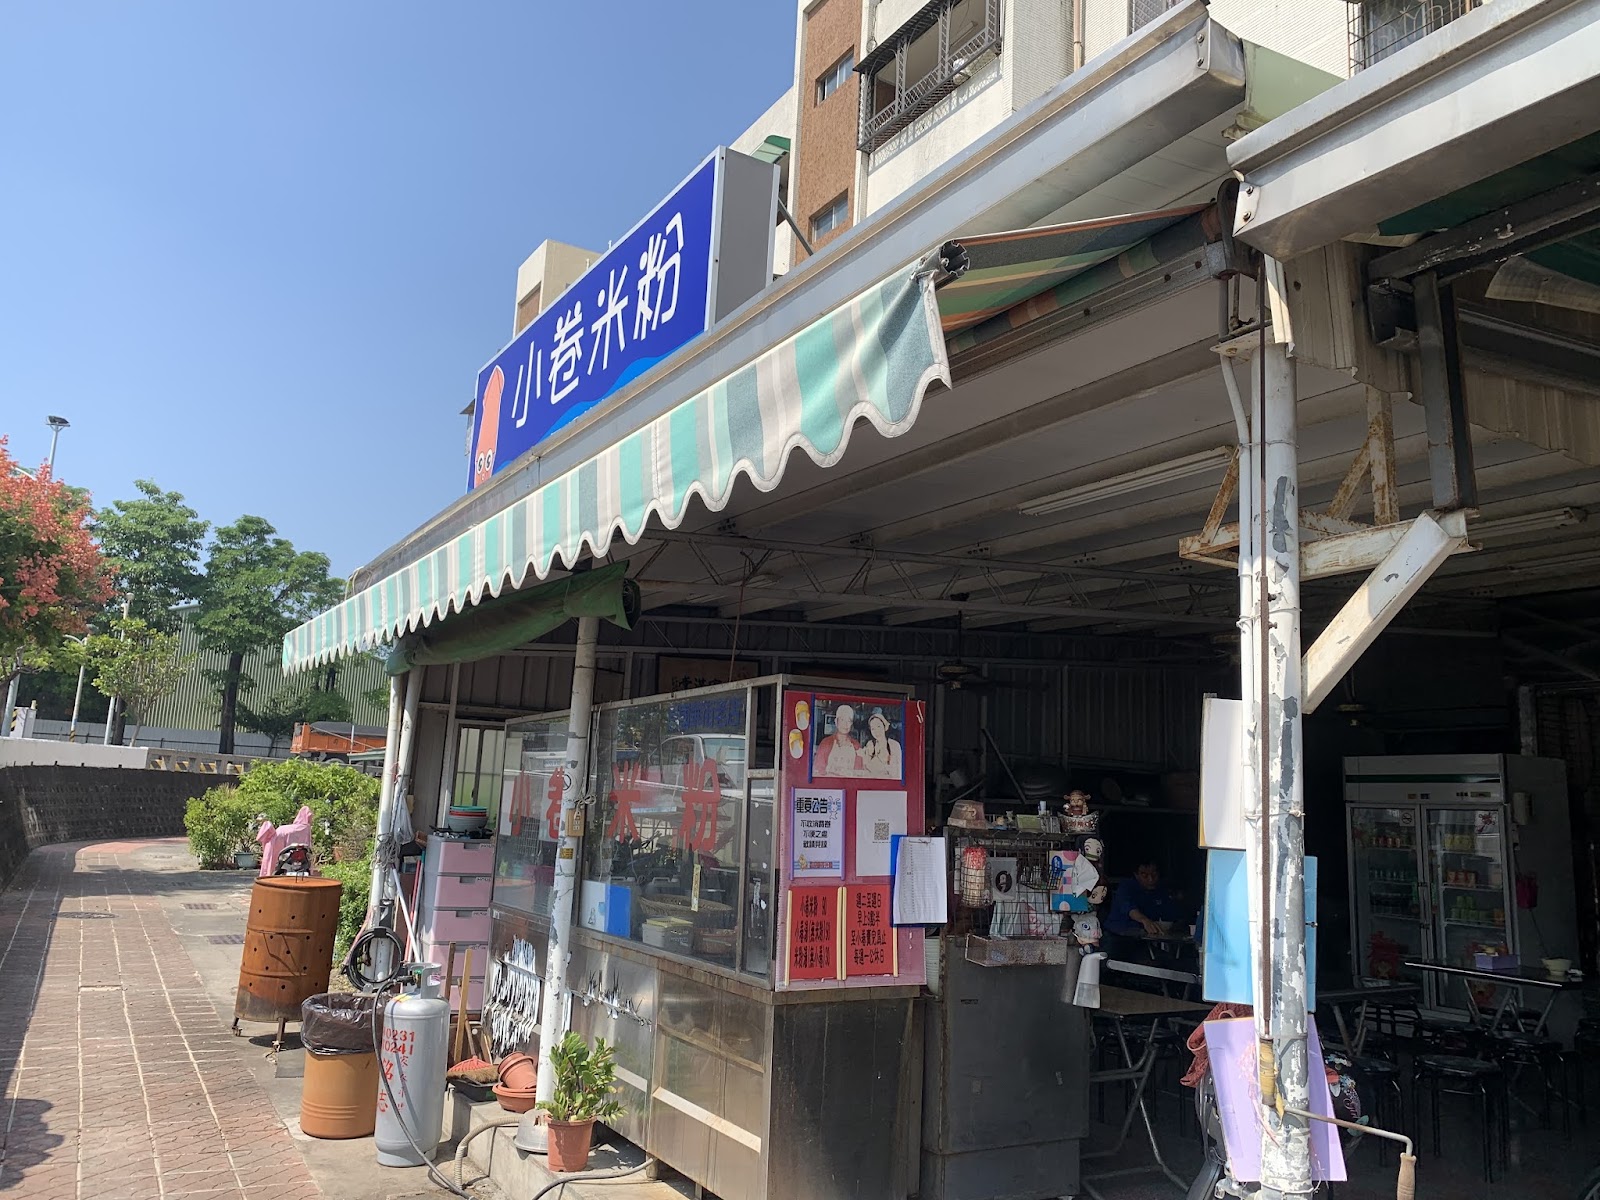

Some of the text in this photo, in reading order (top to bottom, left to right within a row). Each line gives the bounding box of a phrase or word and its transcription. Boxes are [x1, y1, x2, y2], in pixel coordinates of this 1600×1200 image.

[511, 211, 685, 428] 小卷米粉
[796, 797, 828, 814] 重要公告
